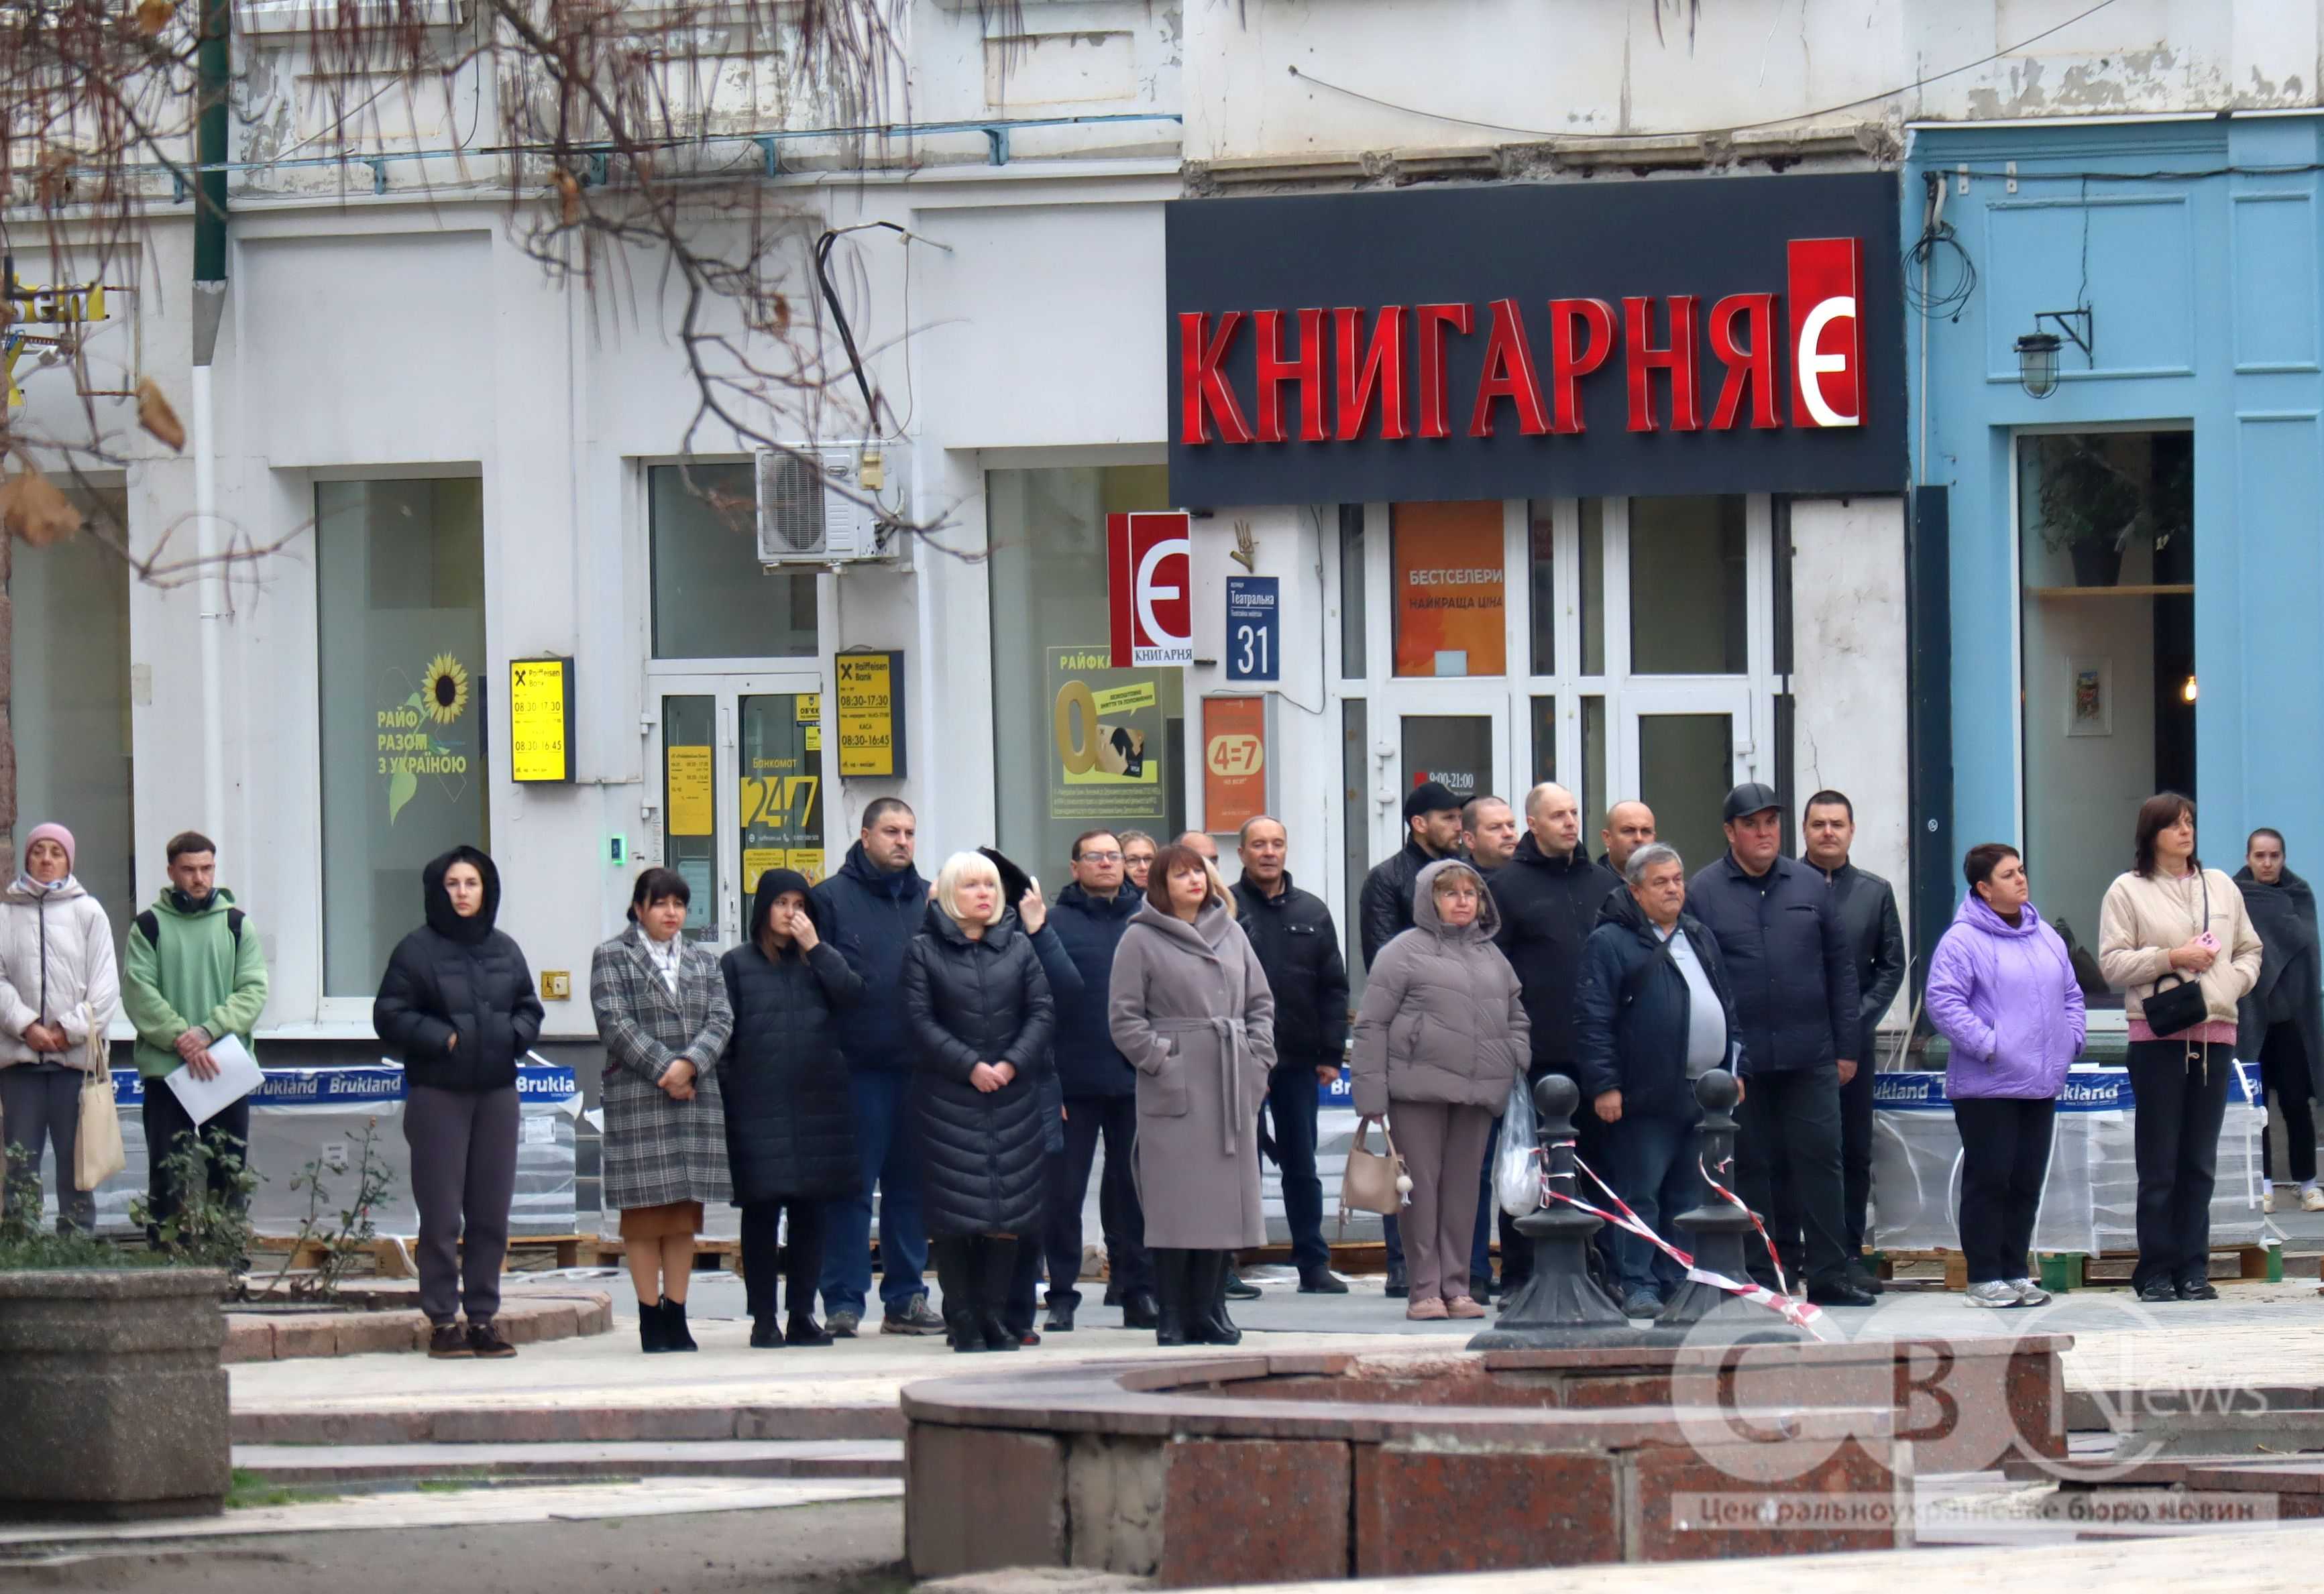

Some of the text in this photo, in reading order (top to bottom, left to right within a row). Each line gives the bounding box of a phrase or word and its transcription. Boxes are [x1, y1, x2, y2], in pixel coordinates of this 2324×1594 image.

[1178, 292, 1859, 444] КНИГАРНЯ Є
[1410, 569, 1502, 585] БЕСТСЕЛЕРИ
[1231, 591, 1274, 607] Театральна
[1410, 594, 1475, 609] НАЙКРАЩА
[1135, 649, 1192, 661] КНИГАРНЯ
[1237, 625, 1268, 674] 31
[854, 662, 887, 671] Raiffeisen
[855, 673, 871, 681] Bank
[841, 695, 888, 706] 08:30-17:30
[378, 705, 418, 728] РАЙФ
[378, 734, 427, 751] РАЗОМ
[842, 735, 889, 746] 08:30-16:45
[390, 751, 467, 773] УКРАЇНОЮ
[753, 758, 798, 768] Банкомат
[1213, 741, 1258, 770] 4=7
[1429, 772, 1474, 788] 9:00-21:00
[329, 1076, 401, 1094] Brukland
[516, 1076, 575, 1092] Brukla
[1873, 1082, 1929, 1099] ukland
[2055, 1084, 2119, 1100] kland
